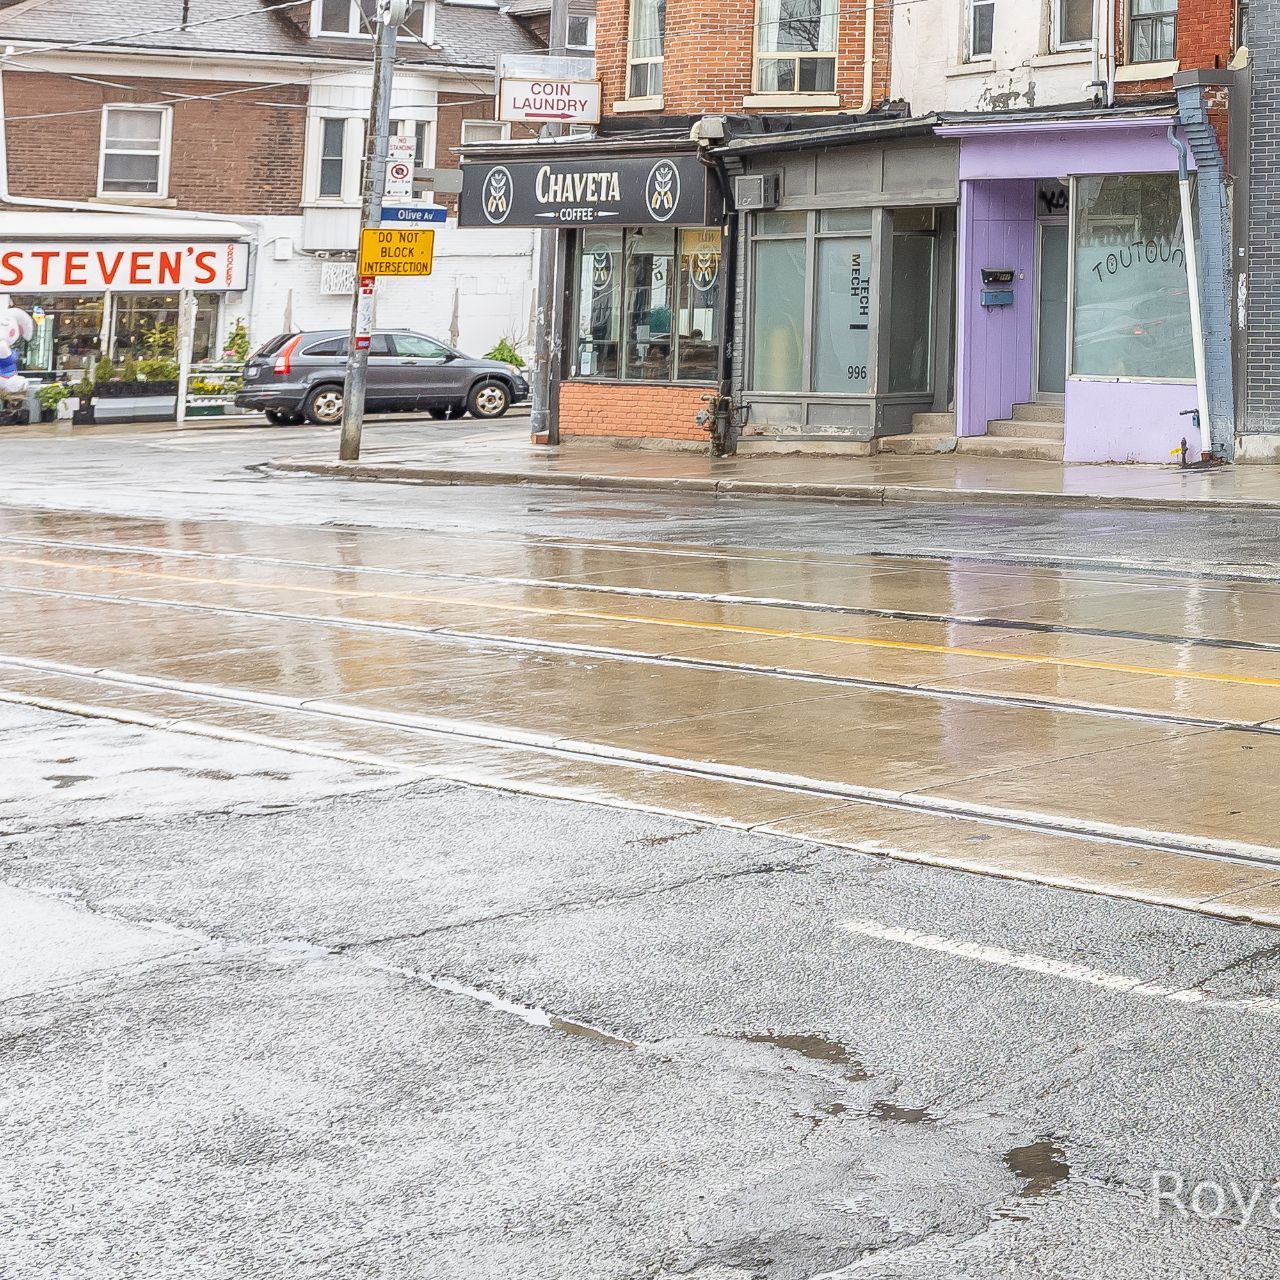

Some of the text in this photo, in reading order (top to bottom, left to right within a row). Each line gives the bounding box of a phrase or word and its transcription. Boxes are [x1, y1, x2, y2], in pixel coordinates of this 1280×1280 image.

[530, 82, 572, 97] COIN
[512, 97, 589, 112] LAUNDRY
[535, 165, 621, 204] CHAVETA
[397, 209, 434, 220] Olive Av
[559, 207, 594, 221] COFFEE
[378, 232, 419, 243] DO NOT
[380, 247, 415, 258] BLOCK
[0, 246, 217, 287] STEVEN'S
[363, 261, 429, 273] INTERSECTION
[850, 253, 861, 297] MECH
[859, 276, 870, 316] TECH
[847, 365, 867, 380] 996
